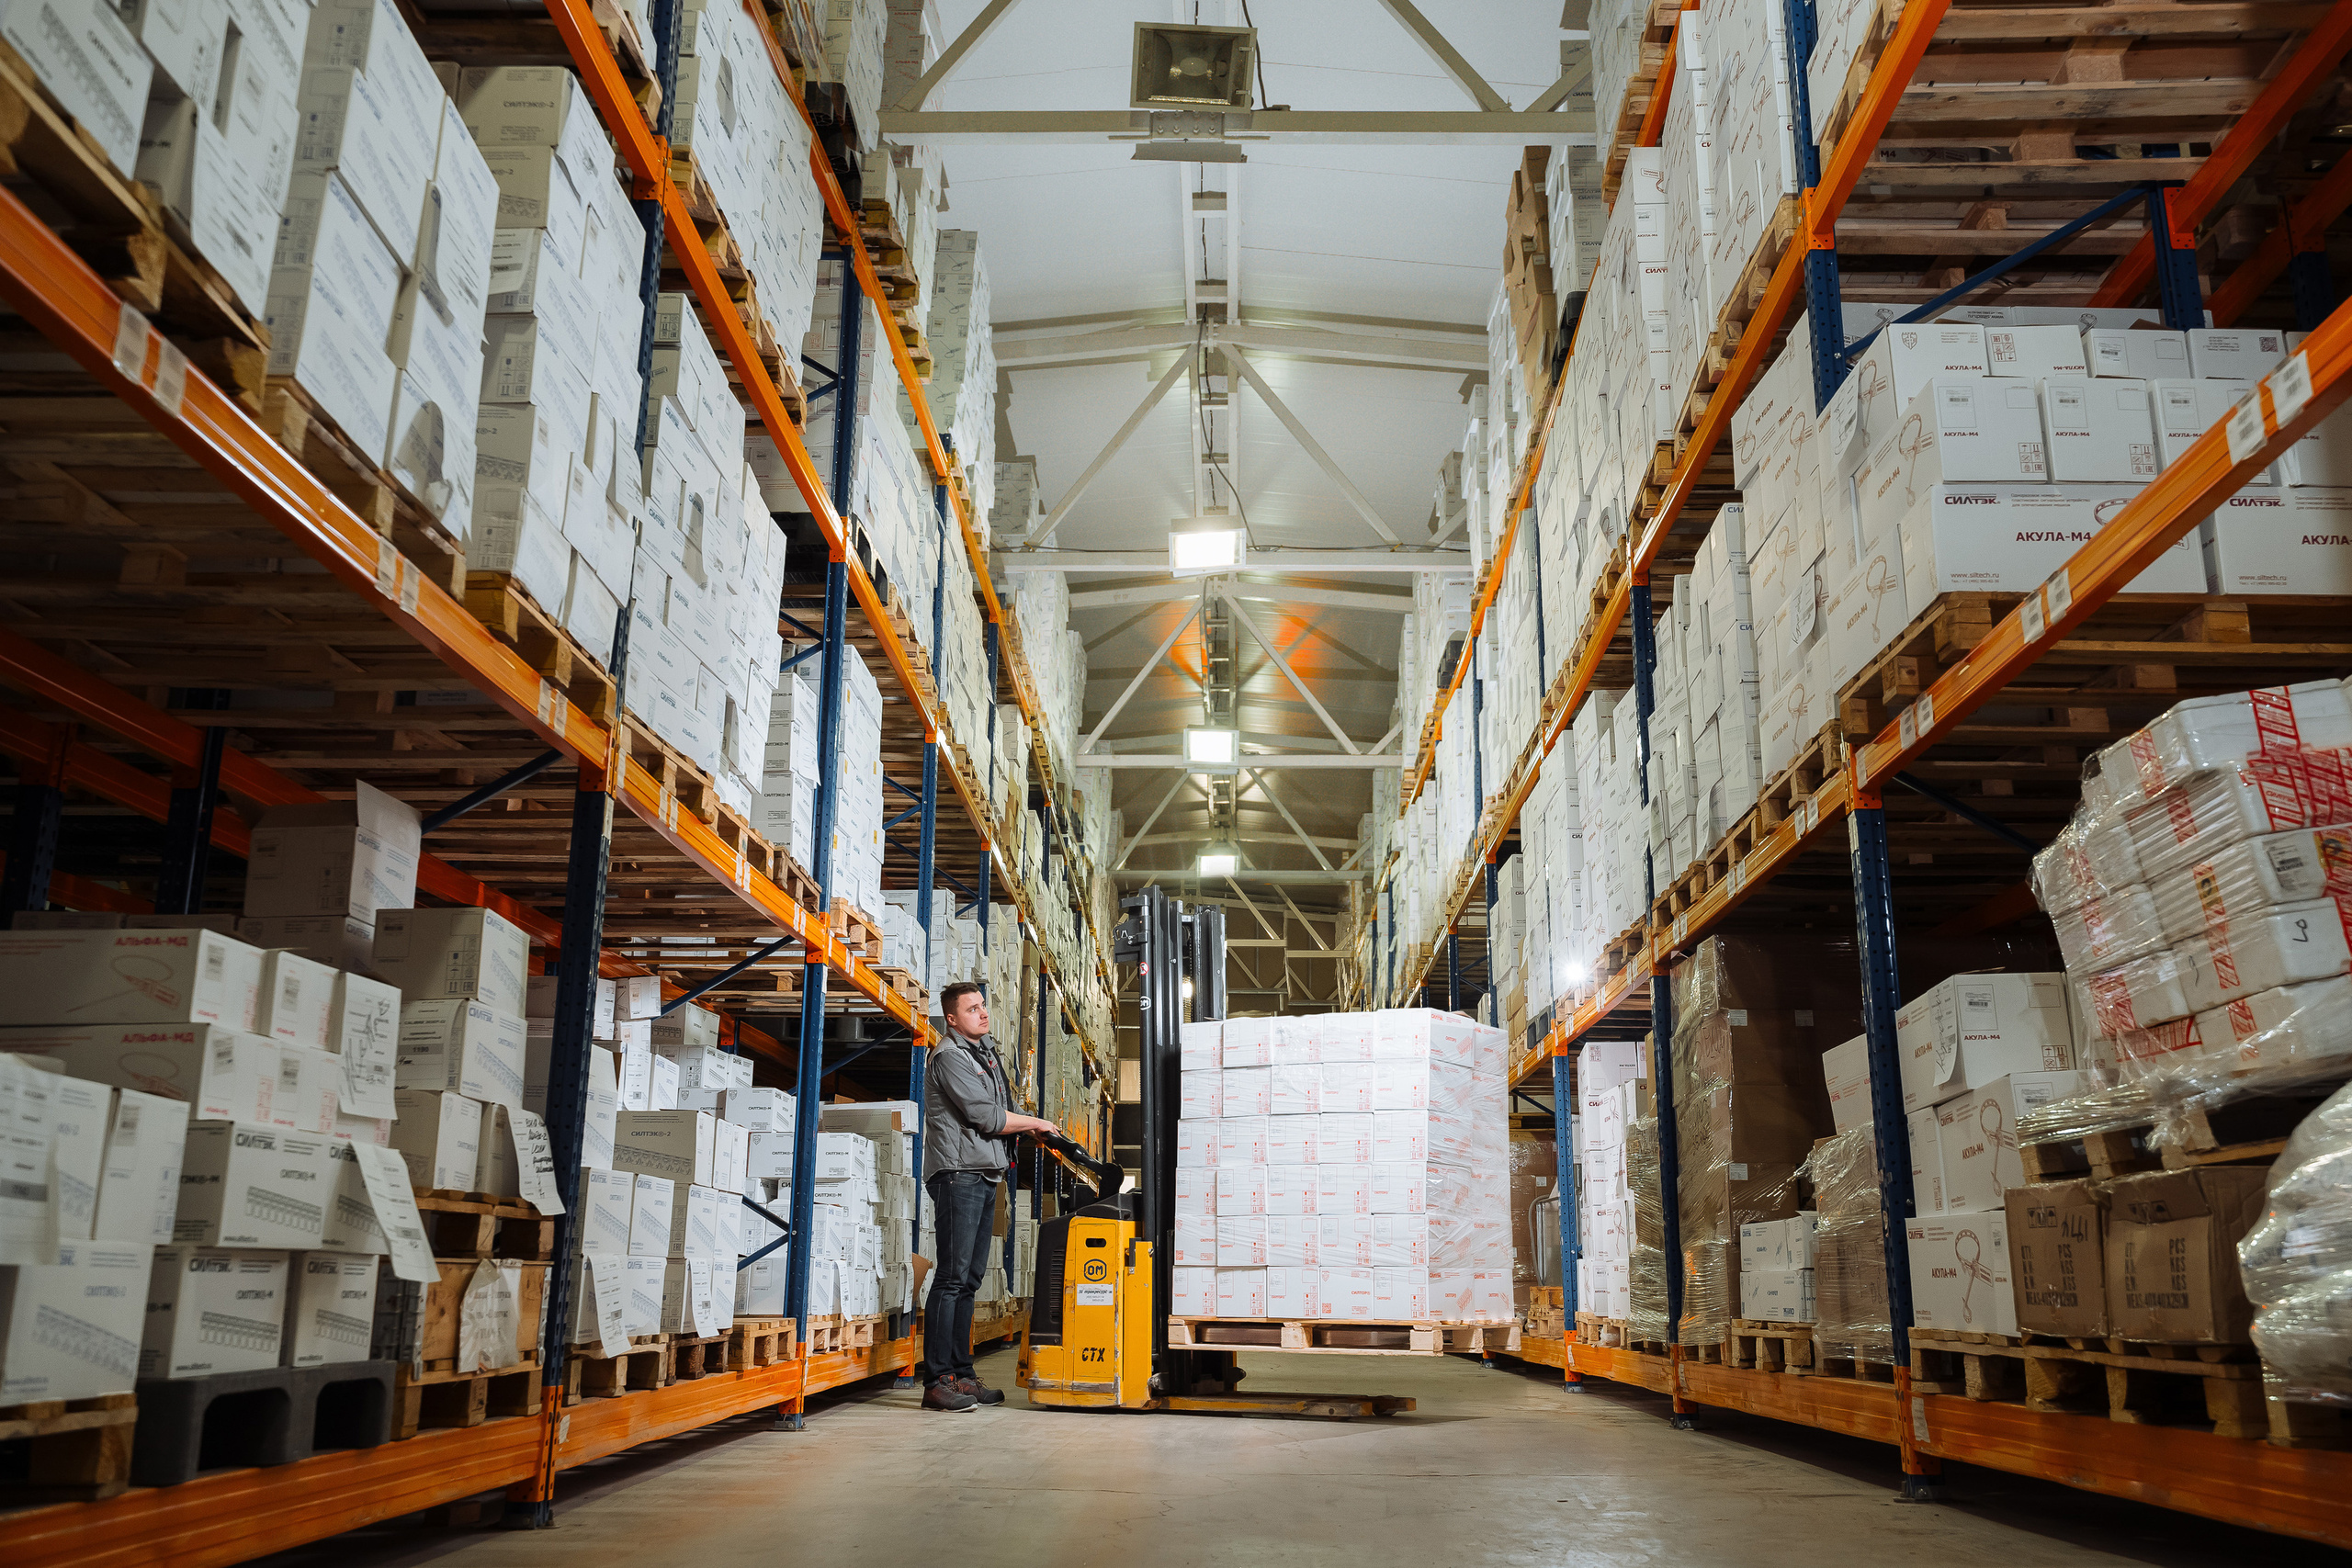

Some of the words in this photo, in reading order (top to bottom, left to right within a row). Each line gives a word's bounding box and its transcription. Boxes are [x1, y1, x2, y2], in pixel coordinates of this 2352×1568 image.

[2229, 498, 2282, 507] СИЛТЭК
[2016, 531, 2091, 542] АКУЛА-М4
[1962, 1143, 1984, 1160] АКУЛА-М4
[2058, 1244, 2073, 1258] PCS
[2169, 1238, 2186, 1255] PCS
[1088, 1265, 1103, 1276] OM
[2169, 1256, 2186, 1273] KGS
[1931, 1268, 1957, 1279] АКУЛА-М4
[2171, 1275, 2187, 1291] KGS
[1081, 1347, 1105, 1363] CTX
